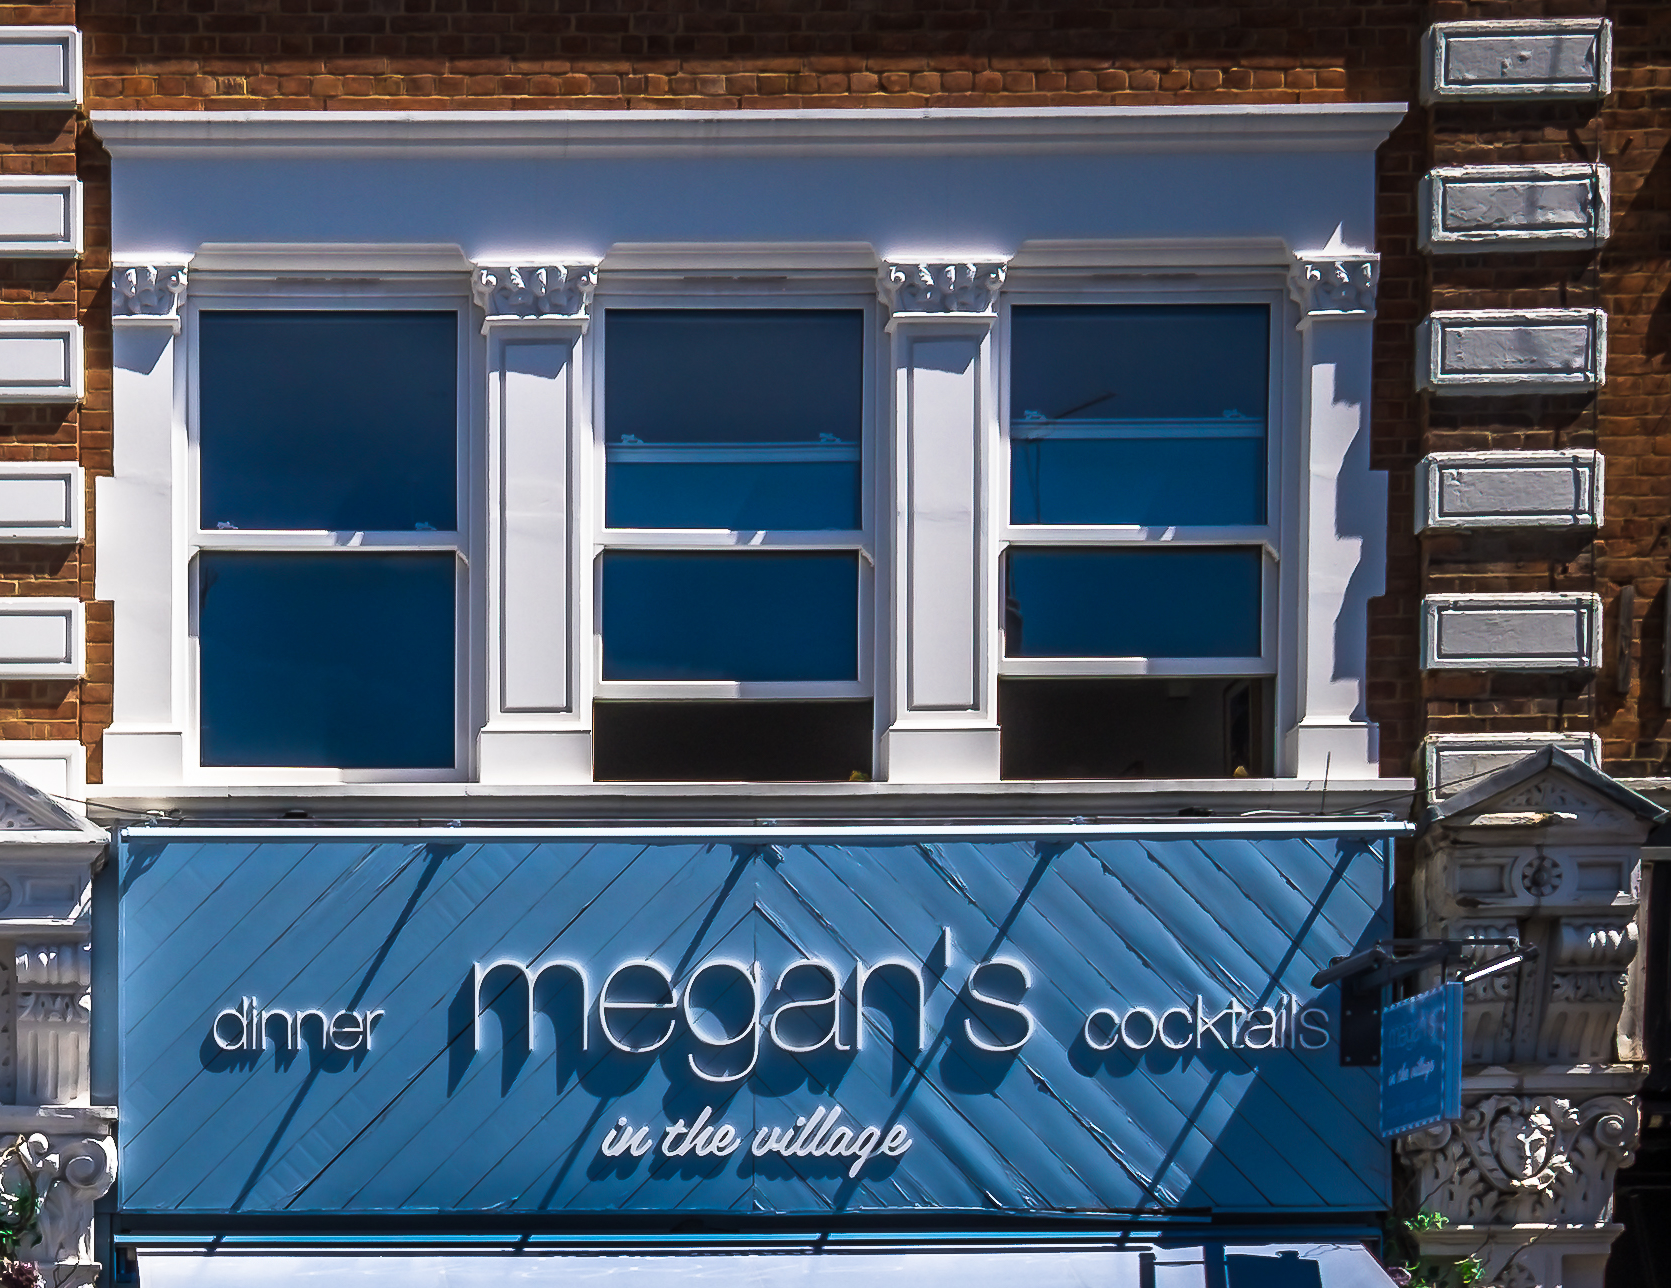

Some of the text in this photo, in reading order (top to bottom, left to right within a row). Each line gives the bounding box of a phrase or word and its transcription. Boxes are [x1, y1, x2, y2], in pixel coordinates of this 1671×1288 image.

[212, 995, 386, 1052] dinner
[472, 925, 1037, 1083] megan's
[1083, 993, 1332, 1050] cocktails
[601, 1105, 914, 1180] in the village
